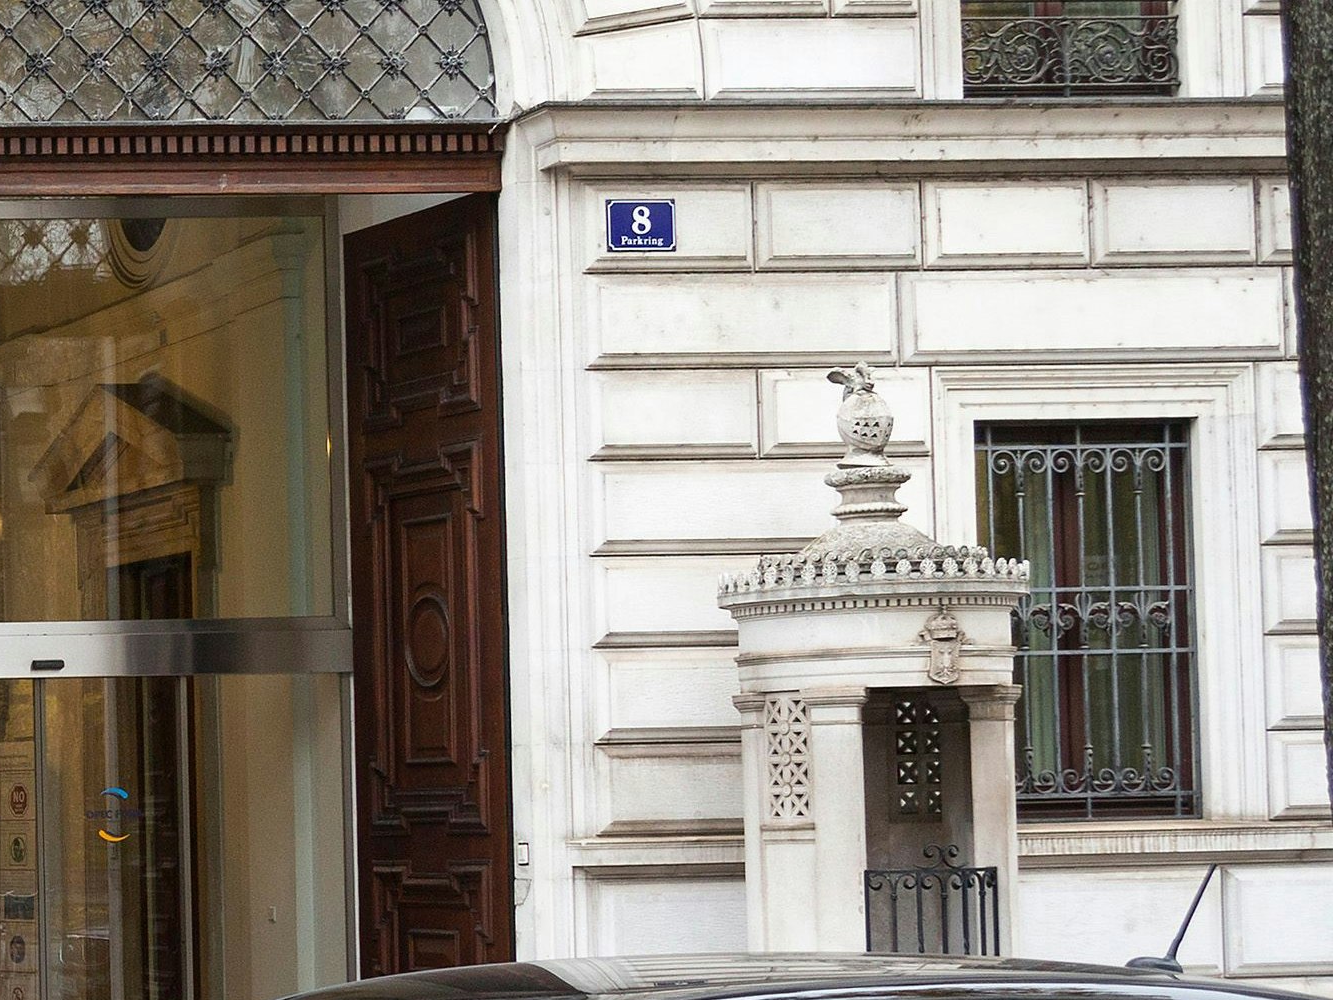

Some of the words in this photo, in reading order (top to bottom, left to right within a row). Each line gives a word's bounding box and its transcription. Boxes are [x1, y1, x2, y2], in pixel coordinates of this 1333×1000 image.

[631, 205, 652, 235] 8
[621, 235, 664, 246] Parkring
[13, 791, 25, 803] NO
